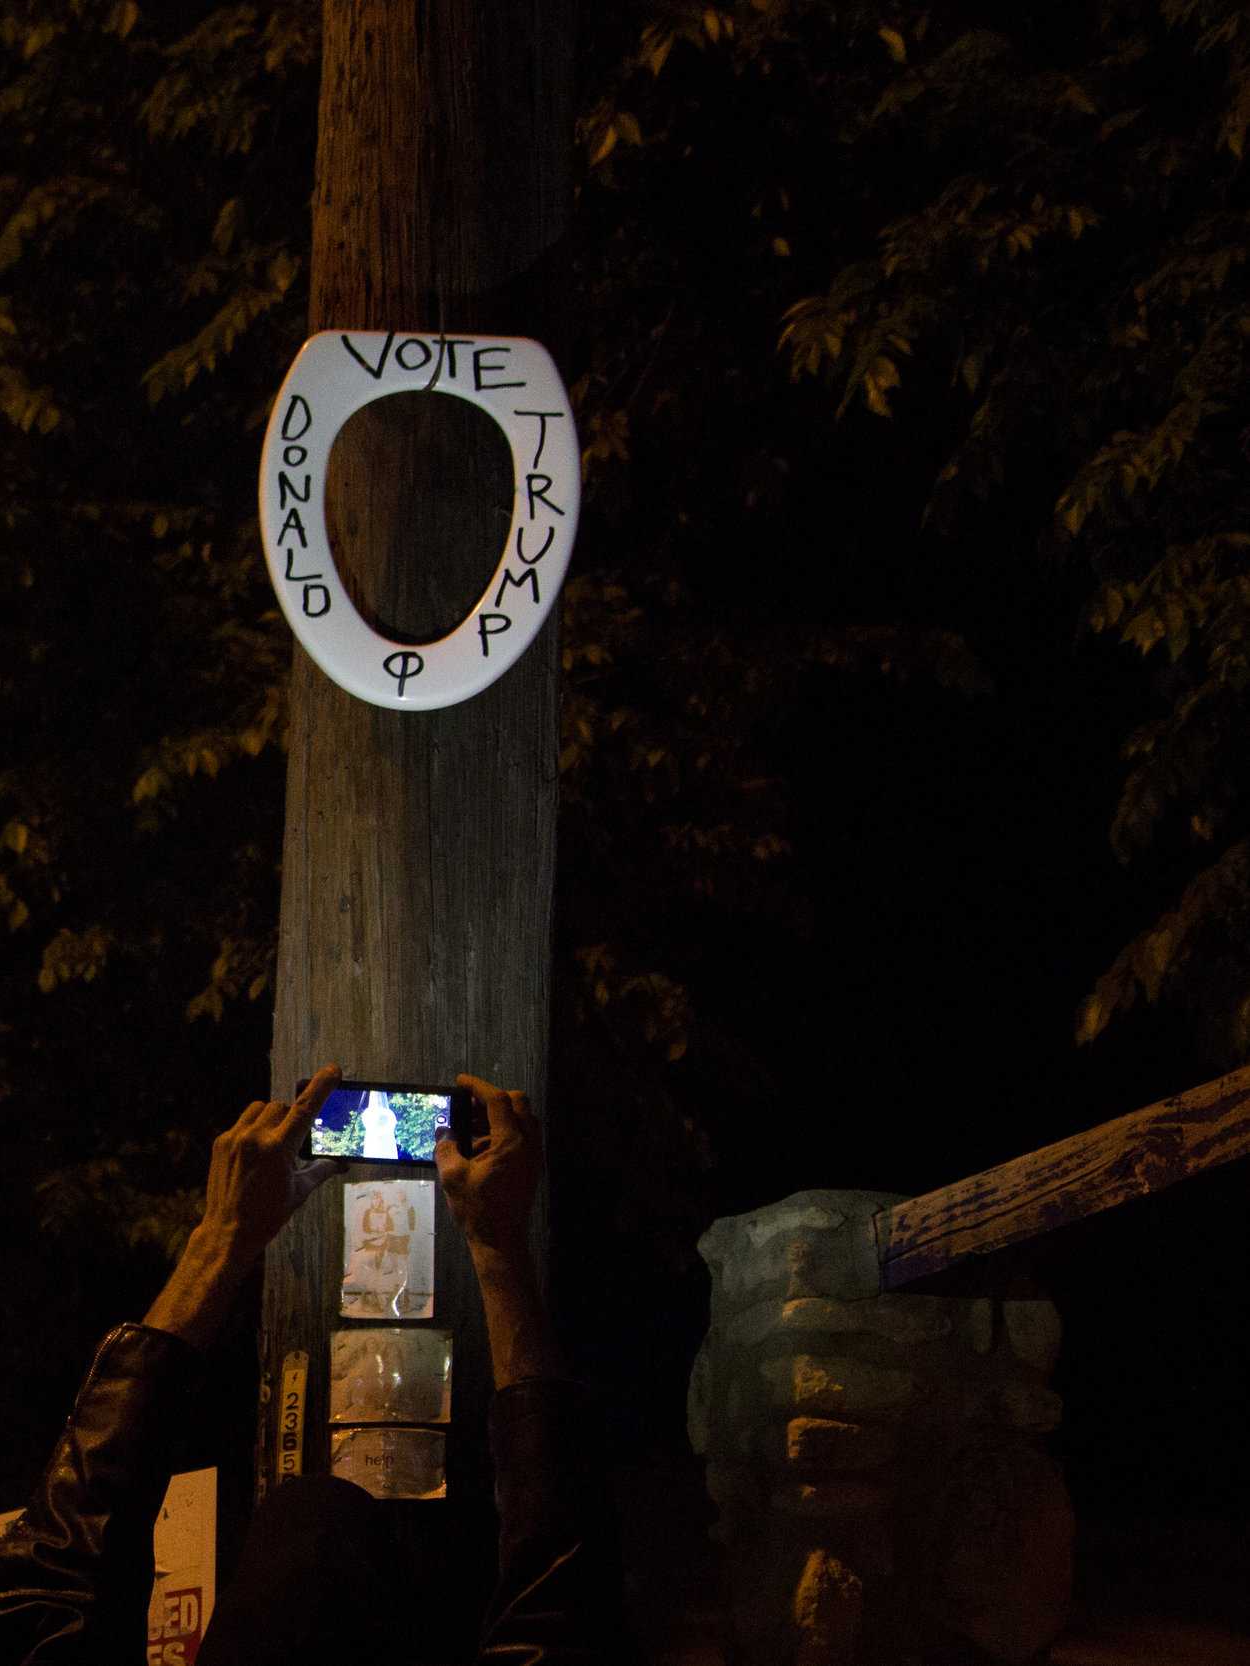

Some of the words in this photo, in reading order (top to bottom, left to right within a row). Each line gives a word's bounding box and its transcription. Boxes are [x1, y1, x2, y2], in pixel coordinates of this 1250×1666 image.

[341, 332, 526, 391] VOTE
[277, 395, 331, 618] DONALD
[479, 411, 565, 657] TRUMP
